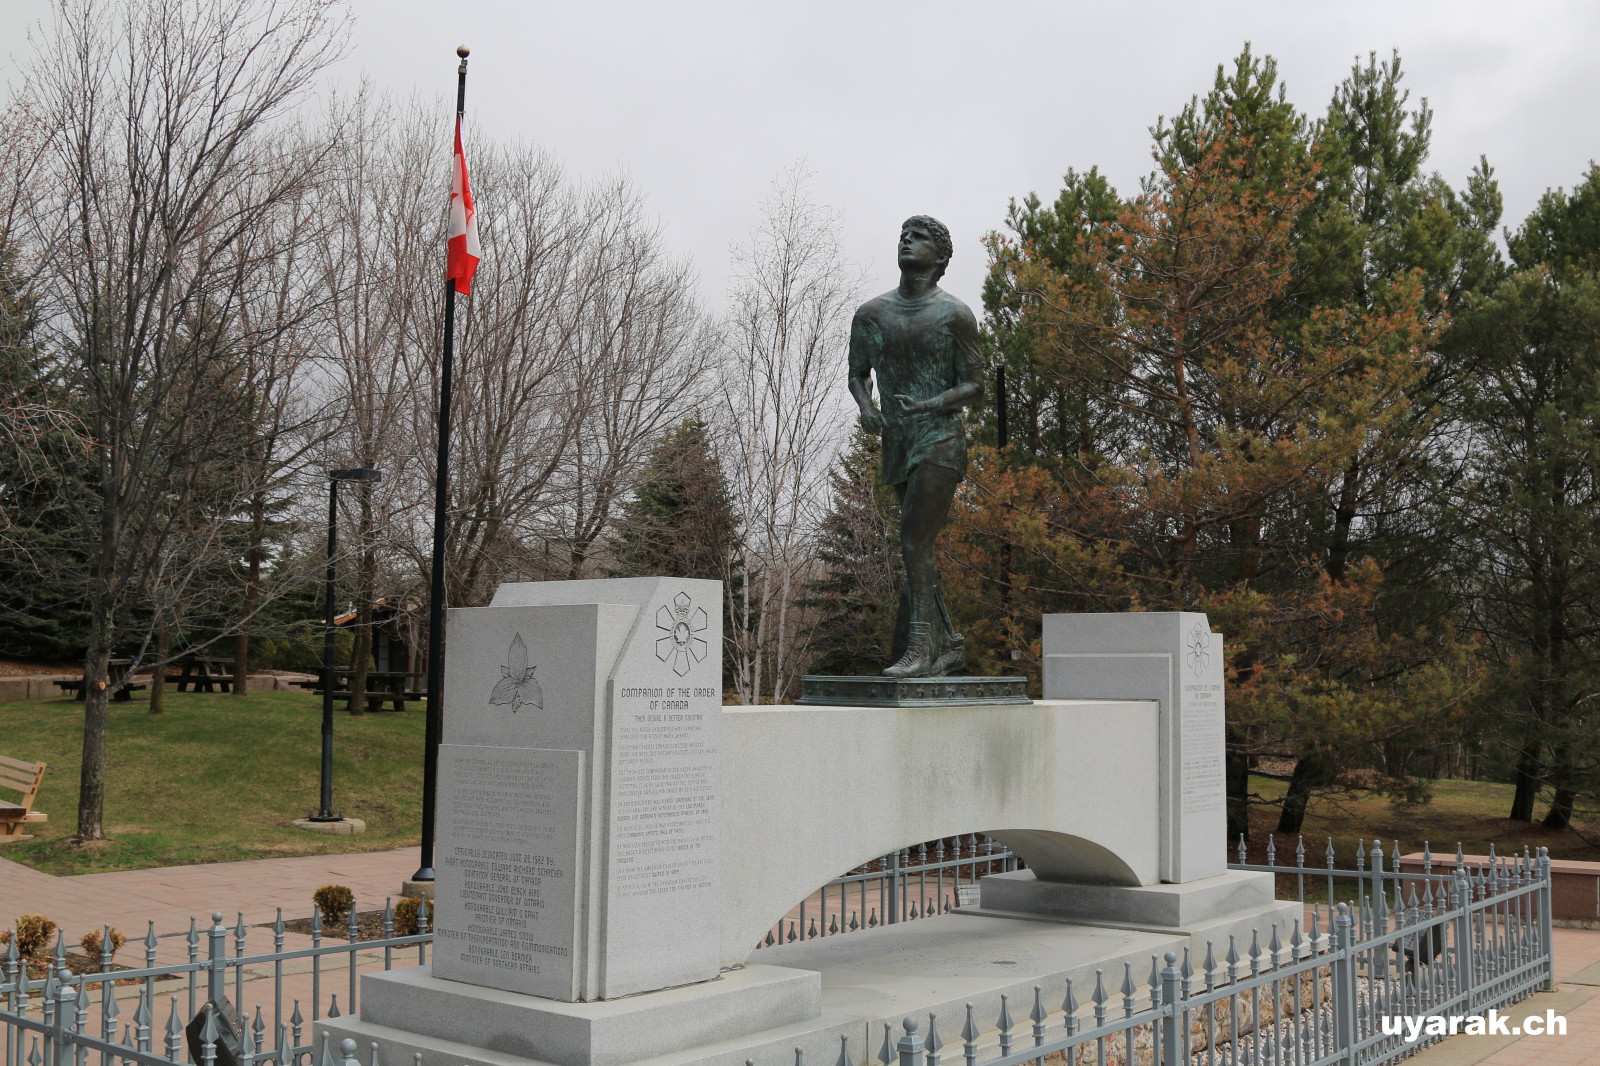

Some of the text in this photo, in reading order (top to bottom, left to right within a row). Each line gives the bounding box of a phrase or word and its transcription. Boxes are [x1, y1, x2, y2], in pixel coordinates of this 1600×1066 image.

[622, 688, 715, 698] COMPANION OF THE ORDER
[650, 700, 688, 710] OF CANADA
[482, 850, 507, 860] DEDICATED
[460, 860, 489, 870] HONOURABLE
[492, 862, 511, 872] EDWARD
[514, 866, 535, 876] RICHARD
[464, 869, 488, 879] GOVERNOR
[491, 872, 511, 882] GENERAL
[522, 876, 541, 886] CANADA
[465, 881, 494, 892] HONOURABLE
[460, 890, 486, 900] LIEUTENANT
[489, 893, 513, 904] GOVERNOR
[524, 898, 544, 908] ONTARIO
[464, 902, 494, 914] HONOURABLE
[496, 906, 517, 917] WILLIAM
[475, 914, 526, 928] PREMIER OF ONTARIO
[468, 924, 534, 941] HONOURABLE JAMES SNOW
[438, 928, 568, 957] MINISTER OF TRANSPORTATION AND COMMUNICATIONS
[469, 945, 532, 962] HONOURABLE LEO BERNIER
[461, 954, 482, 964] MINISTER
[485, 957, 490, 966] OF
[493, 958, 517, 971] NORTHERN
